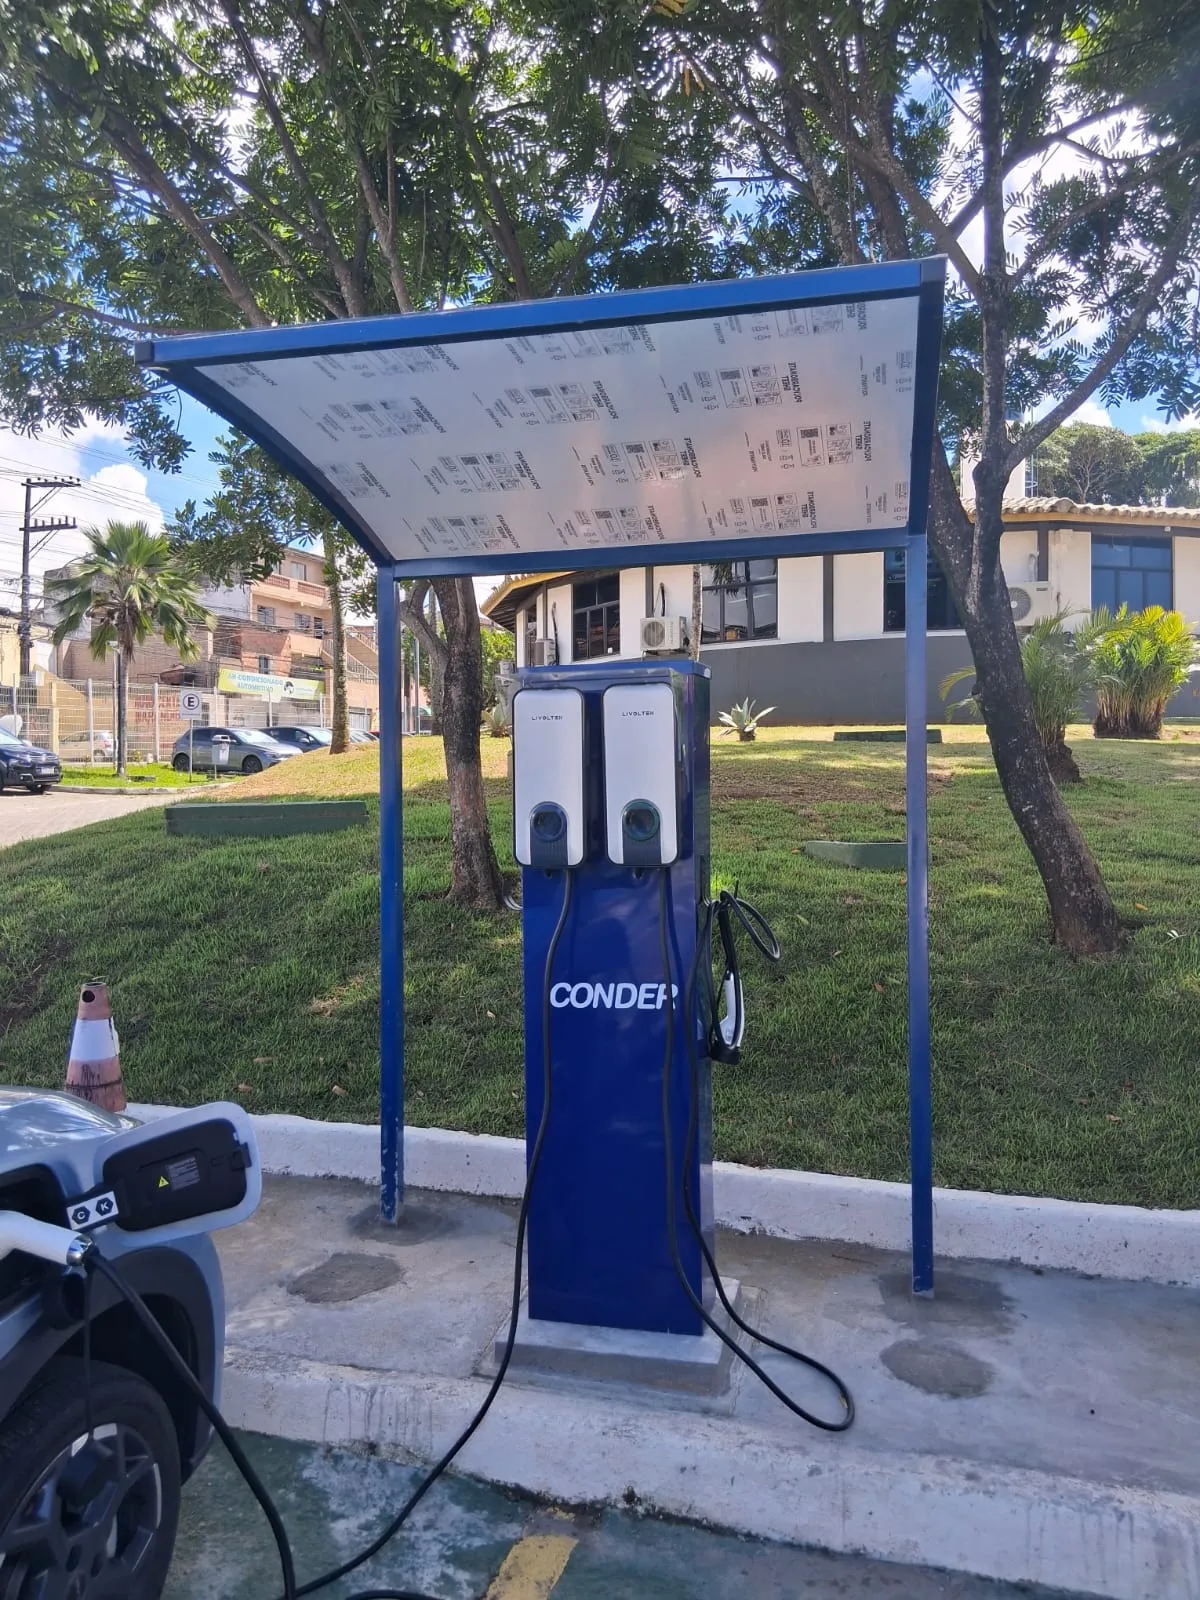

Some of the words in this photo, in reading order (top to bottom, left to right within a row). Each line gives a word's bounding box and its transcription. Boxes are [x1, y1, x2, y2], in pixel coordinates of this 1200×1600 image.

[550, 982, 679, 1010] CONDER
[77, 1211, 86, 1220] C
[101, 1202, 109, 1211] K
